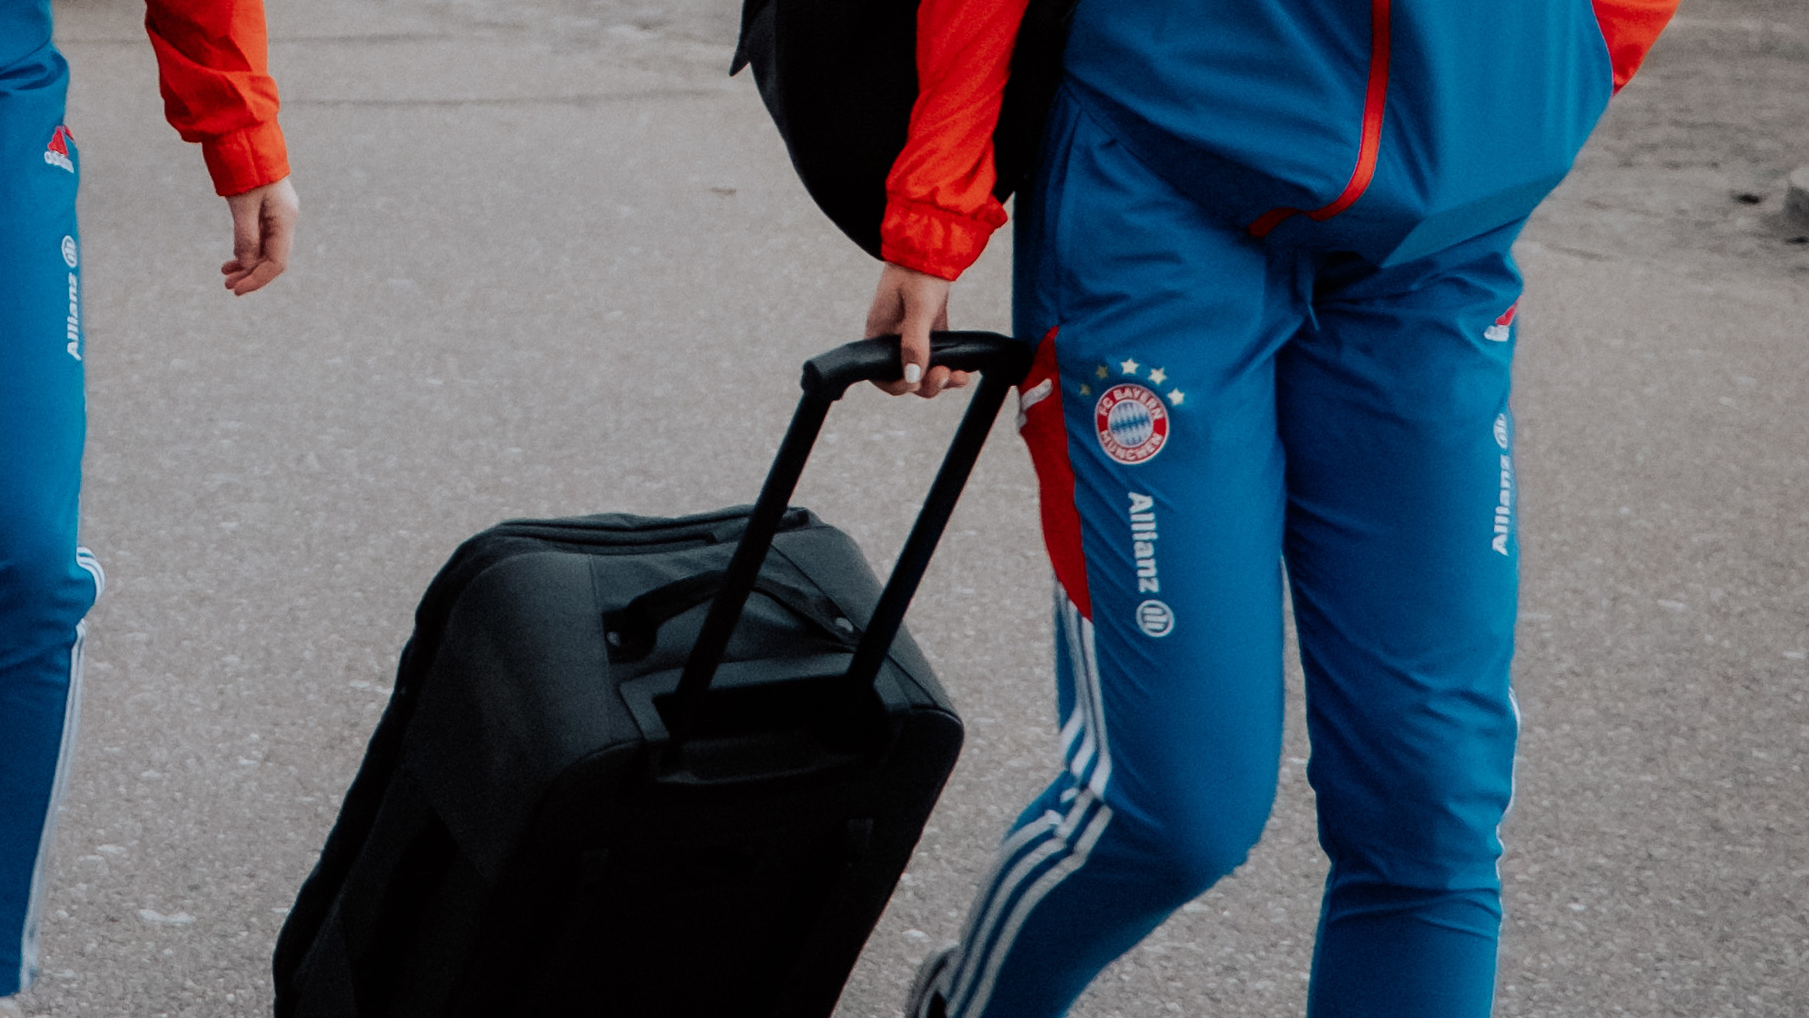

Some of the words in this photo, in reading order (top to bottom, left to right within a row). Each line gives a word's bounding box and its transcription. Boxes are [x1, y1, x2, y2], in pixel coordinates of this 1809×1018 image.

[67, 272, 82, 361] Allianz
[1099, 395, 1114, 417] FC
[1113, 386, 1165, 420] BAYERN
[1128, 491, 1159, 594] Allianz
